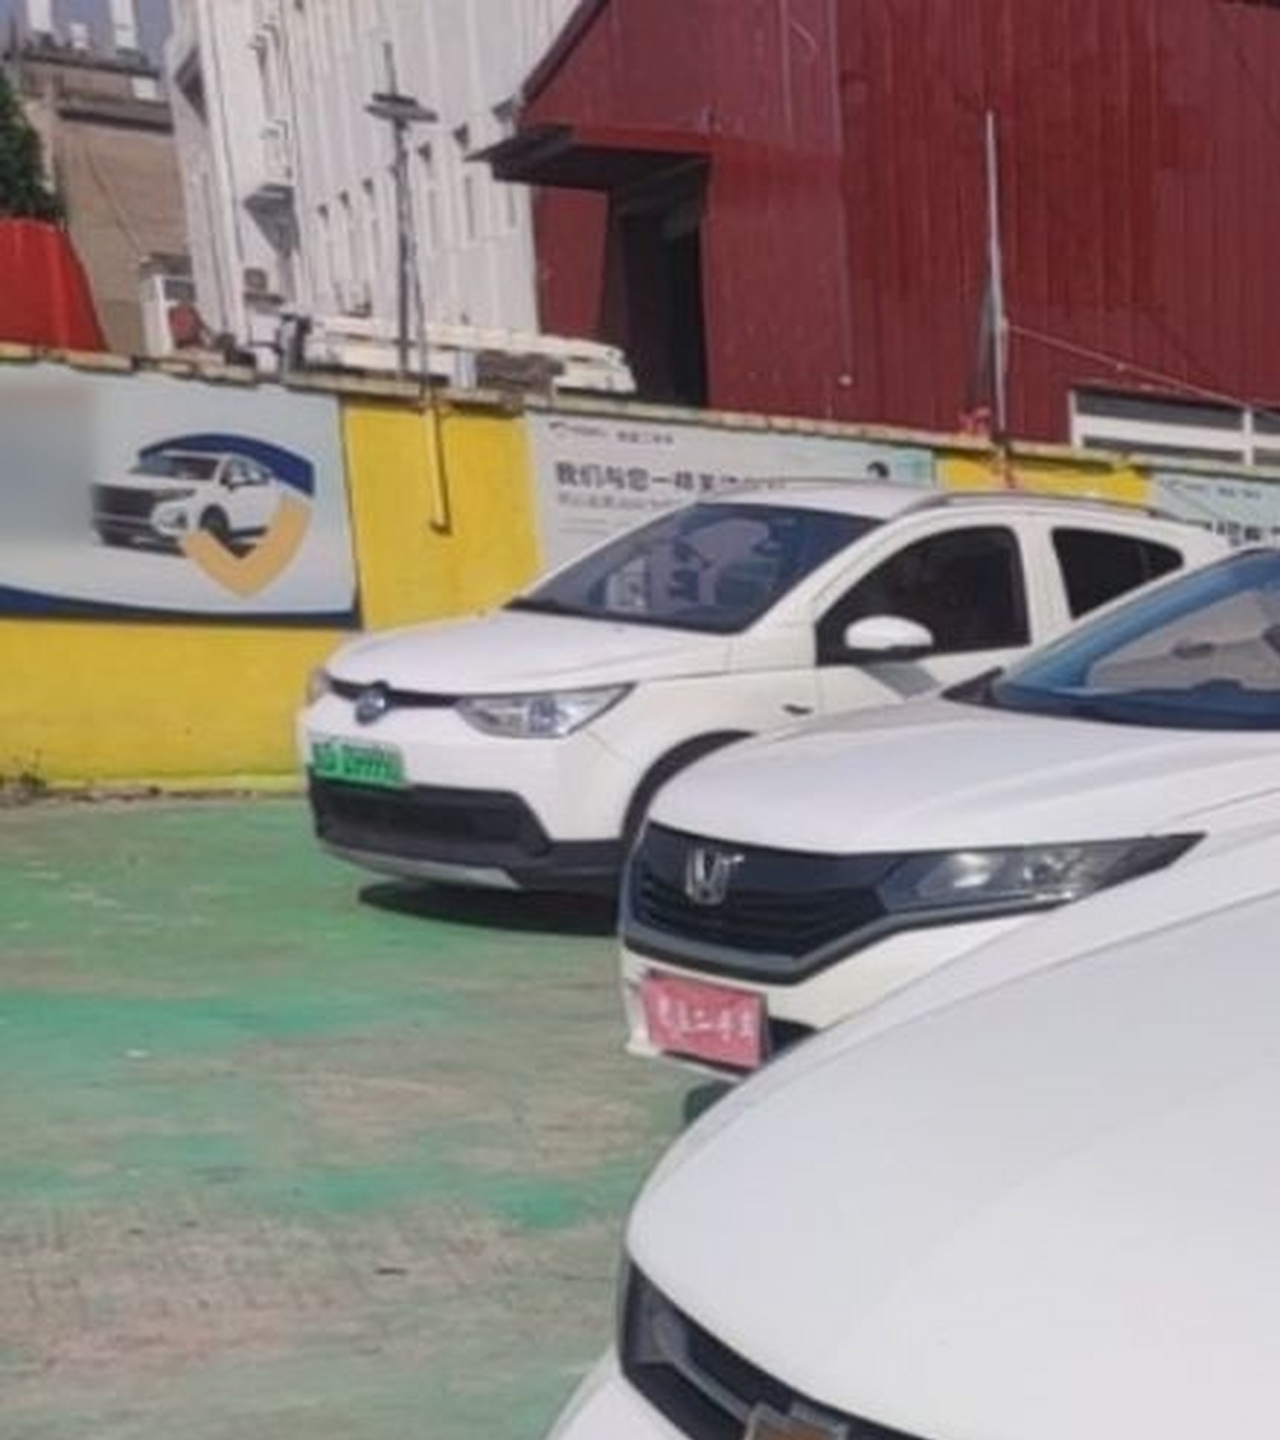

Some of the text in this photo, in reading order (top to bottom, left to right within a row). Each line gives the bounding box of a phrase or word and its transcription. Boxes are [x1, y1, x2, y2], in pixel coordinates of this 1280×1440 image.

[556, 461, 738, 492] 我们与您一样
